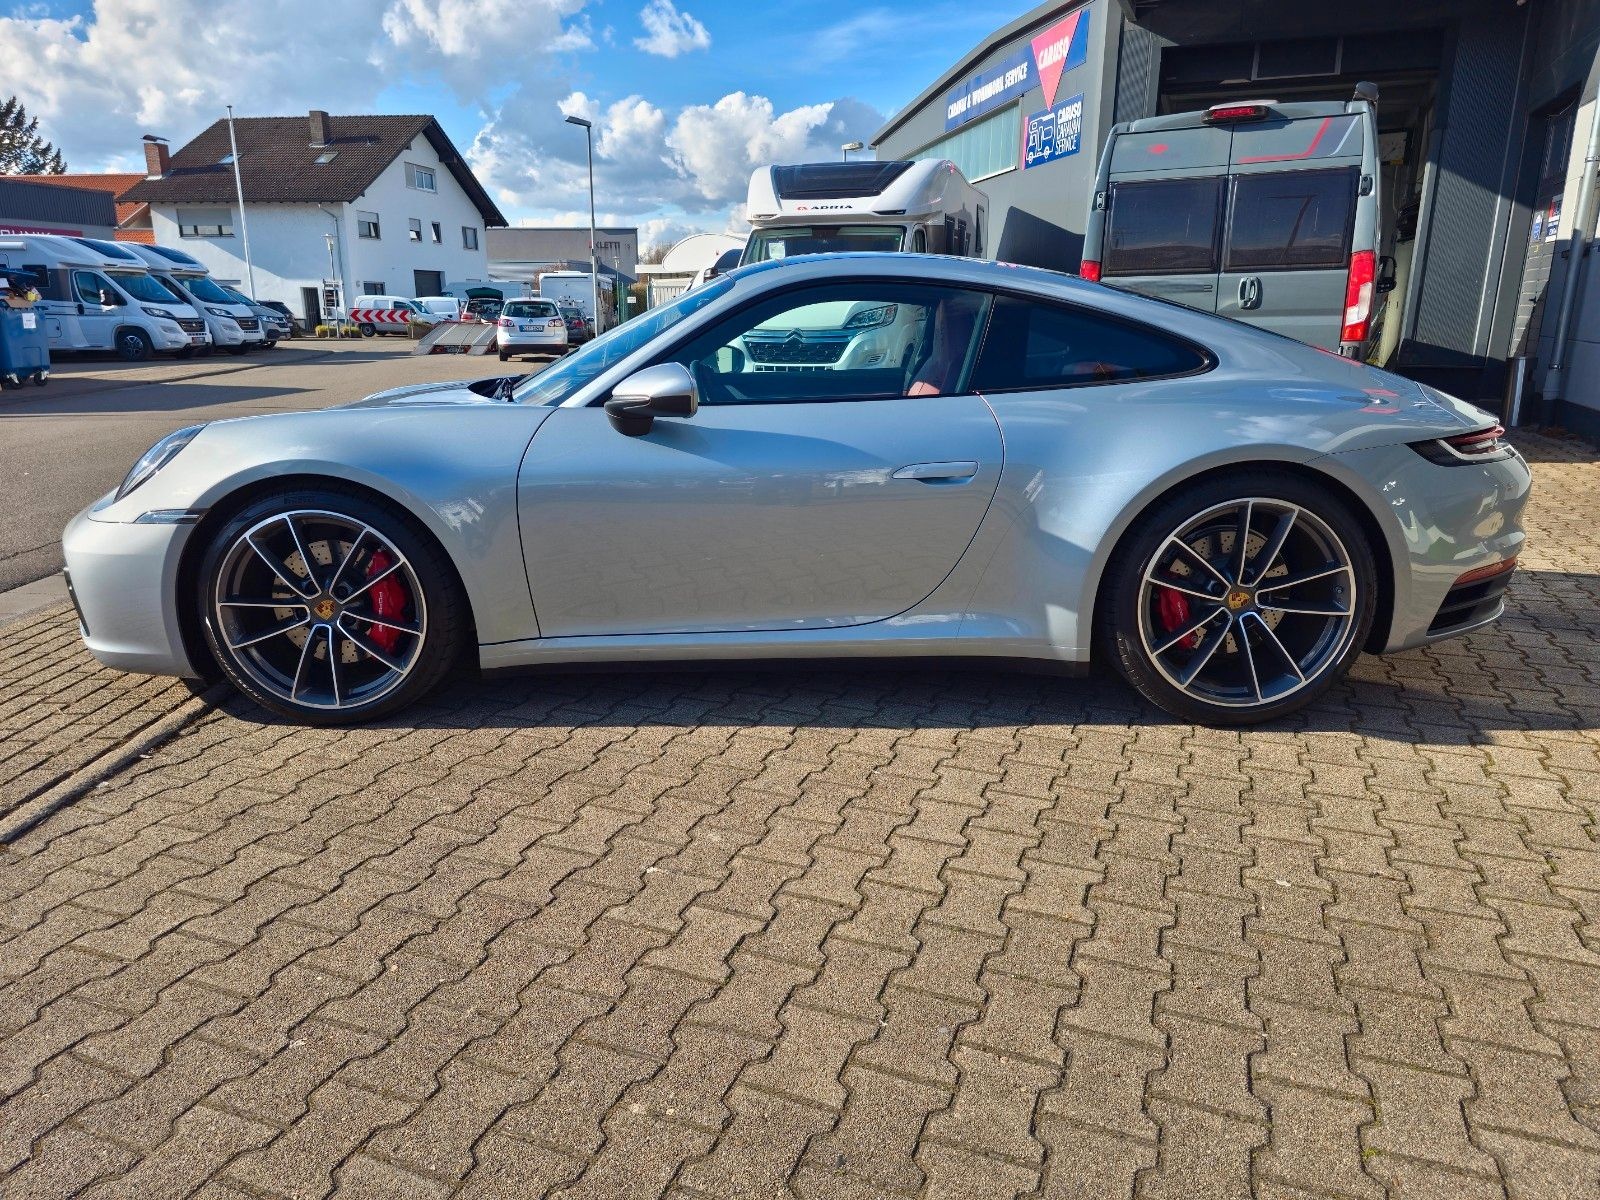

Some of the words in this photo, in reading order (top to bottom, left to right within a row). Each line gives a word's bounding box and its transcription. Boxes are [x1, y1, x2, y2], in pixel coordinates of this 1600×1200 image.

[1038, 36, 1069, 70] CARUSO
[1004, 62, 1028, 90] SERVICE
[1058, 101, 1082, 124] CARUSO
[1056, 116, 1081, 140] CARAVAN
[1055, 133, 1078, 155] SERVICE
